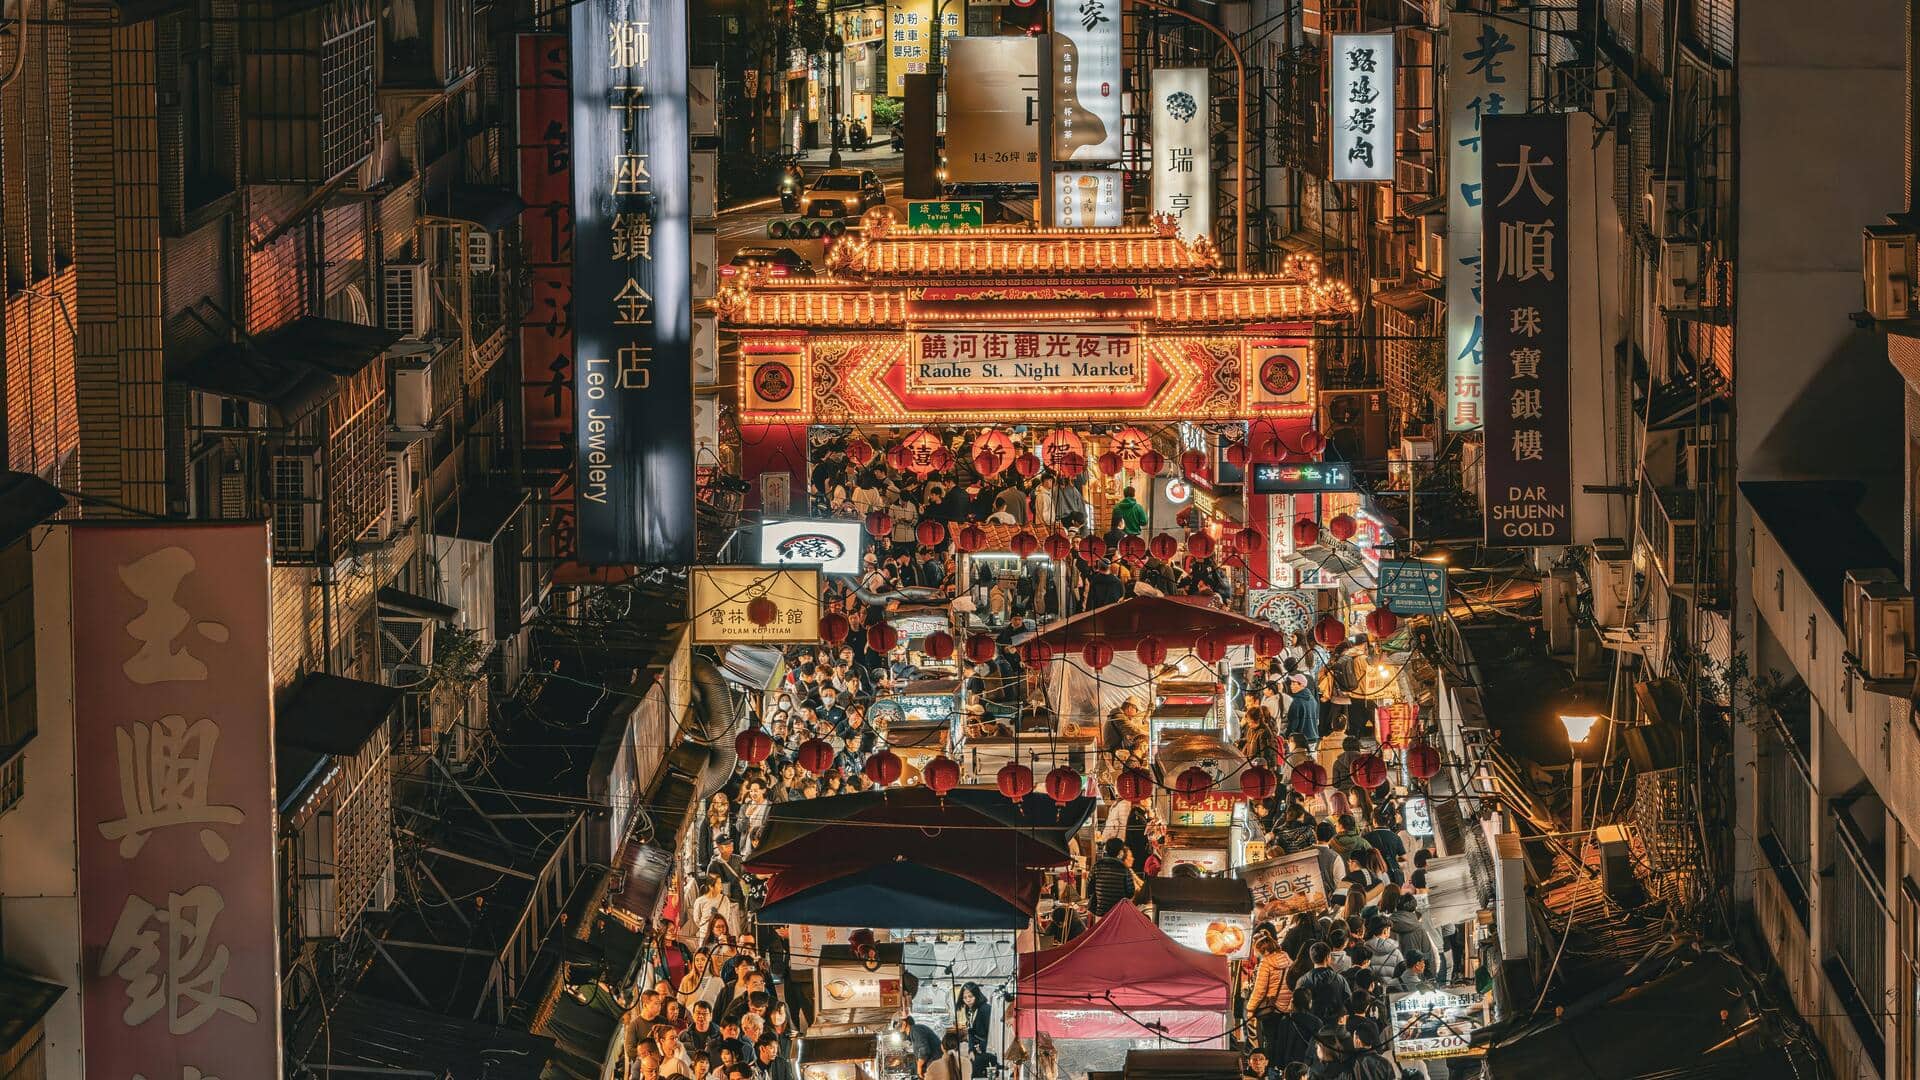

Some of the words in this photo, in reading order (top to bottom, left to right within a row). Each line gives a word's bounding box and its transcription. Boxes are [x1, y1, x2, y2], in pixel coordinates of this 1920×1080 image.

[894, 13, 958, 25] 奶粉、布
[609, 20, 653, 390] 獅子座鑽金店
[1496, 144, 1555, 282] 大順
[920, 333, 1131, 359] 饒河街觀光夜市
[587, 359, 610, 400] Leo
[919, 363, 971, 378] Raohe
[982, 364, 1003, 378] St.
[1014, 362, 1061, 381] Night
[1072, 361, 1135, 377] Market
[1509, 305, 1543, 461] 珠寶銀樓
[1454, 375, 1480, 424] 玩具
[584, 408, 612, 505] Jewelery
[1509, 486, 1546, 501] DAR
[1493, 503, 1564, 520] SHUENN
[1503, 522, 1555, 537] GOLD
[709, 607, 804, 625] 寶林館
[722, 627, 750, 635] POLAM
[752, 627, 791, 635] KOPITIAM
[98, 545, 259, 1080] 玉興銀
[1431, 1037, 1463, 1049] 200
